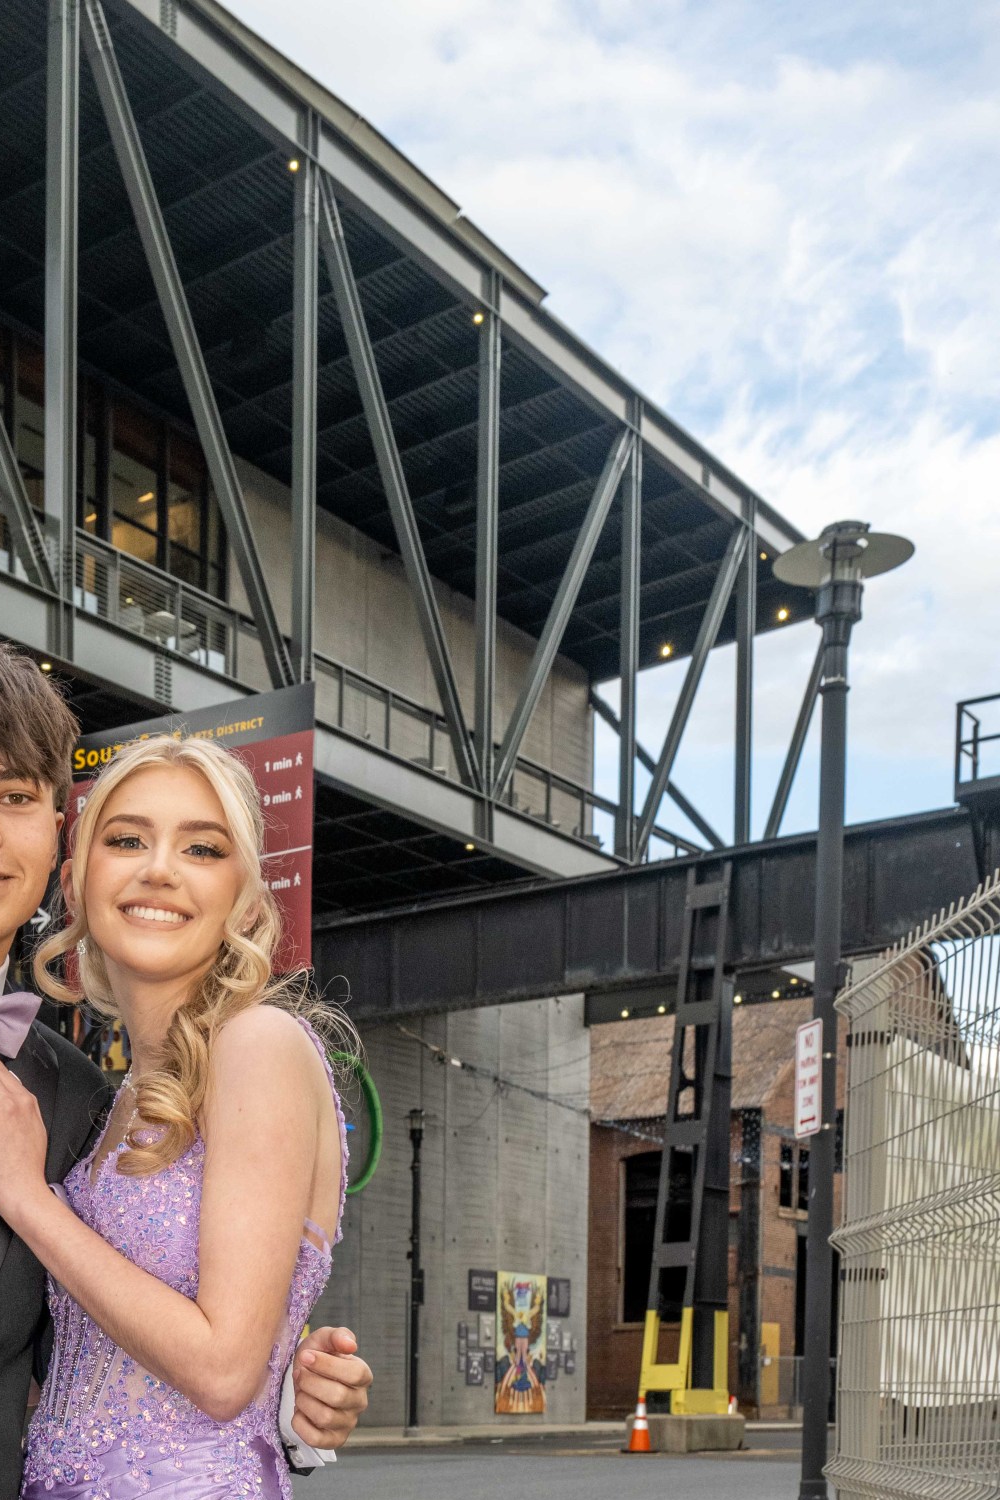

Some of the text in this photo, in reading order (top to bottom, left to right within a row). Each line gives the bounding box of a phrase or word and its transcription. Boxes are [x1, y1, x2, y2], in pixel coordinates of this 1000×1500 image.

[216, 716, 265, 738] DISTRICT
[264, 757, 293, 773] 1 min
[263, 791, 292, 806] 9 min
[271, 876, 291, 891] min
